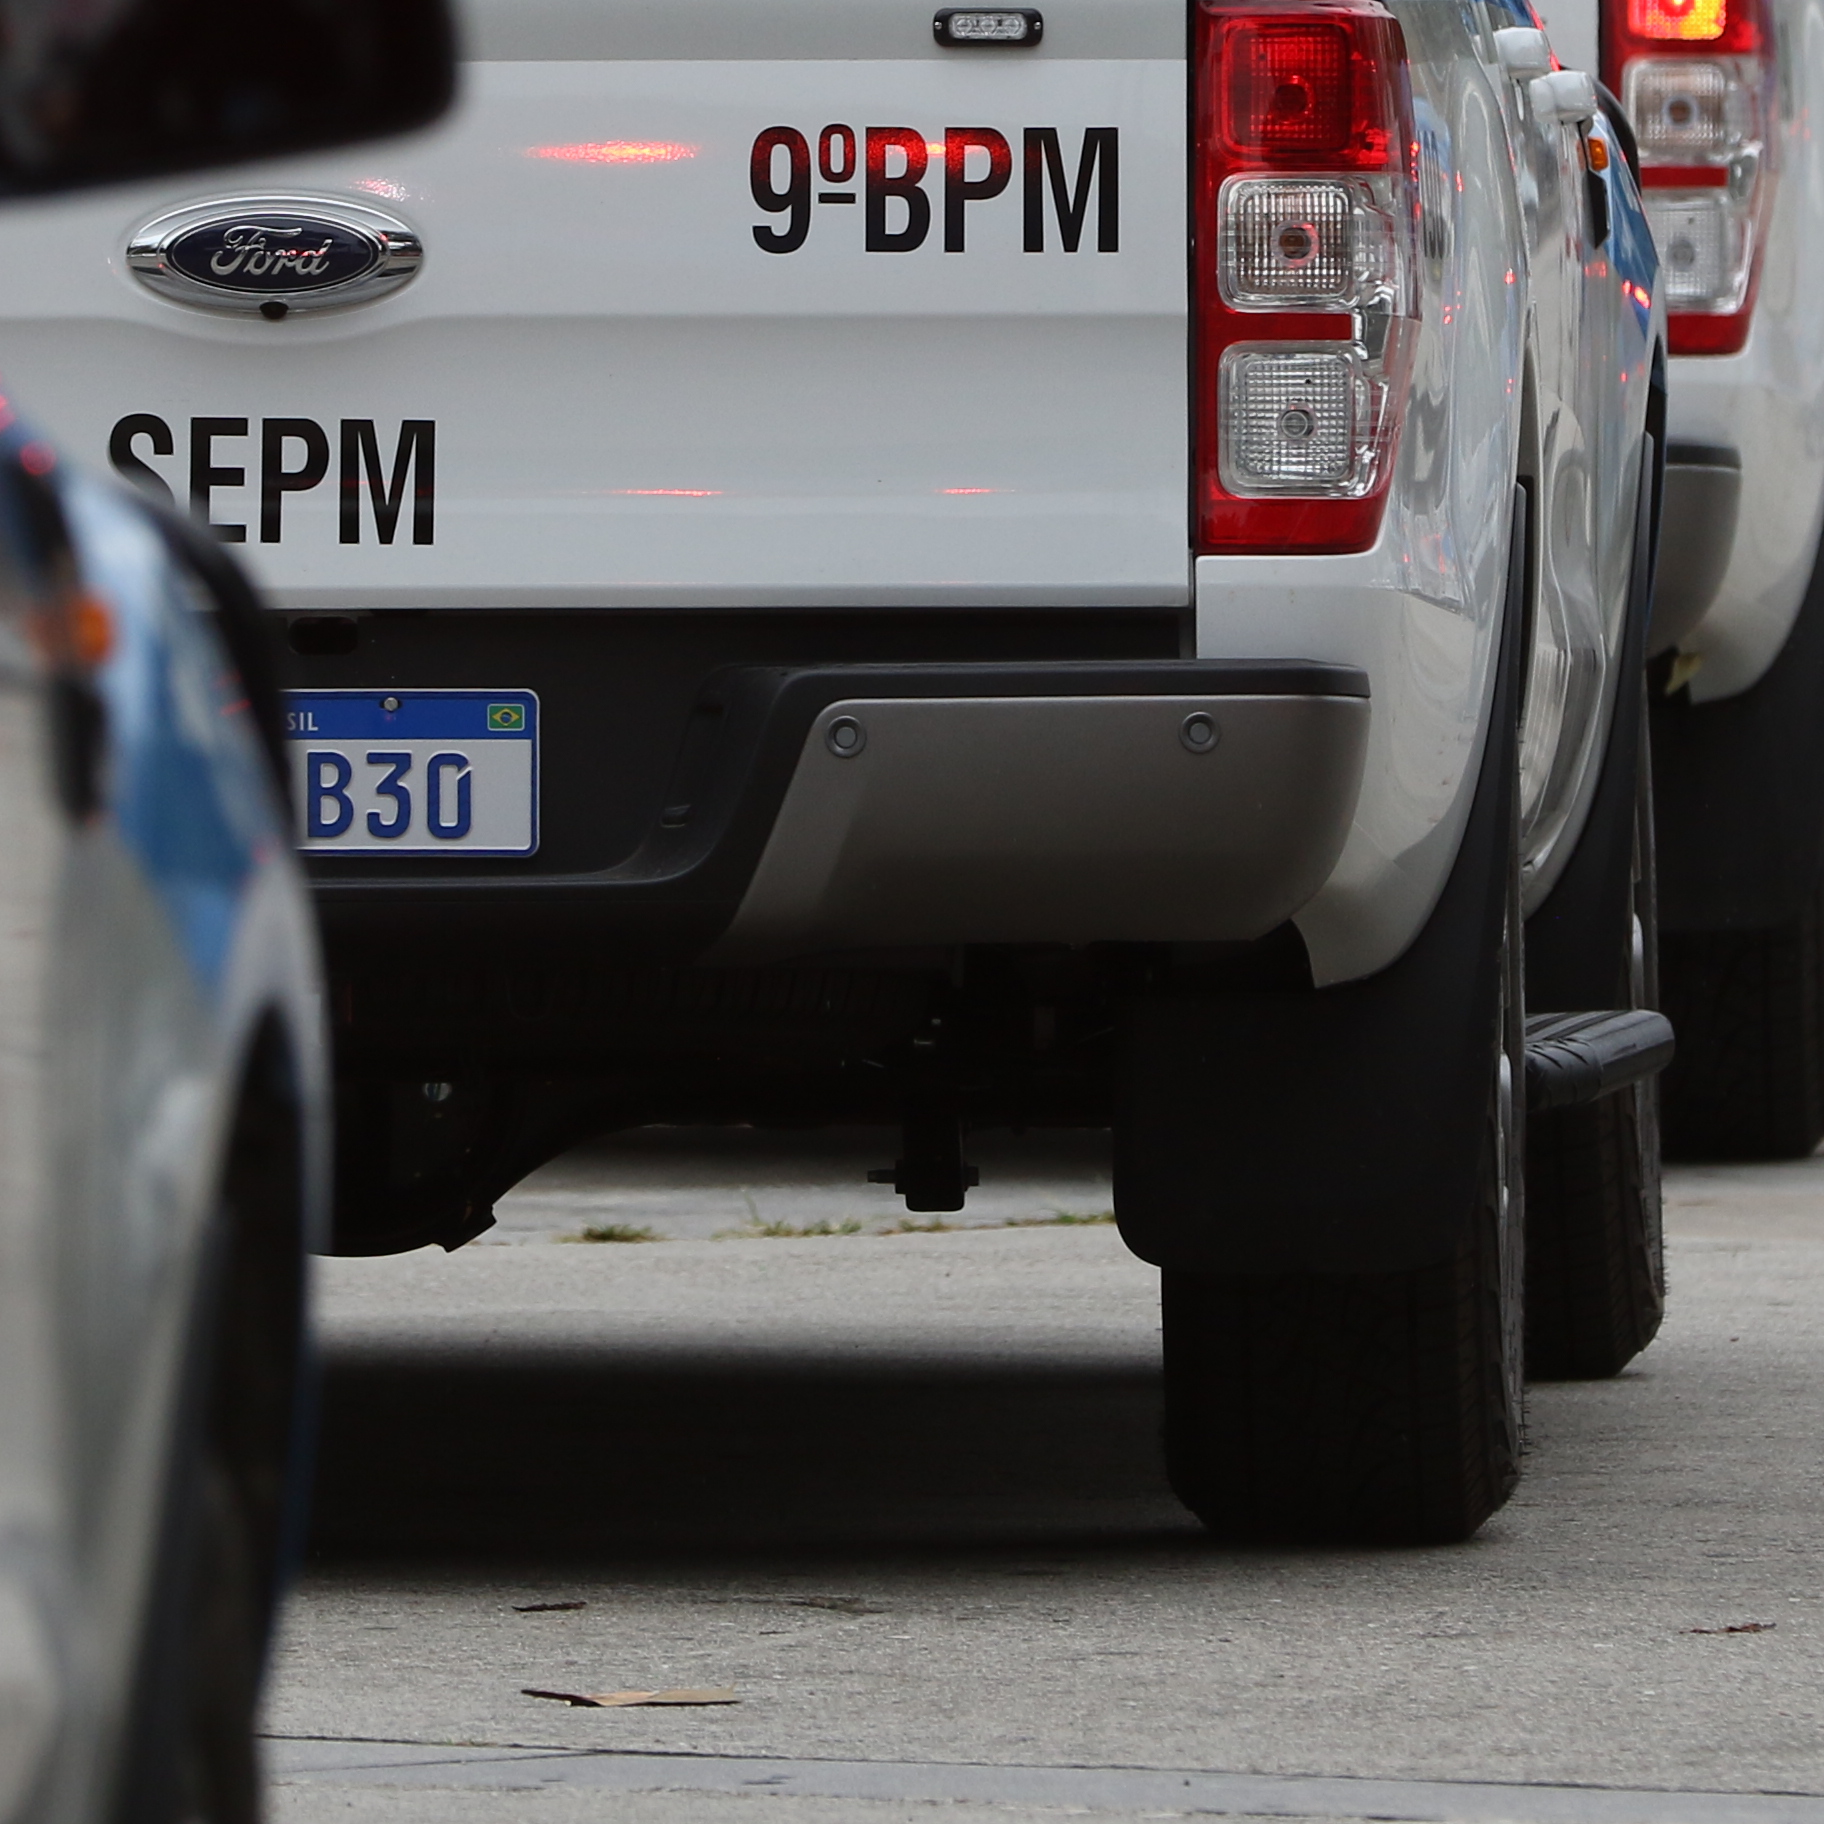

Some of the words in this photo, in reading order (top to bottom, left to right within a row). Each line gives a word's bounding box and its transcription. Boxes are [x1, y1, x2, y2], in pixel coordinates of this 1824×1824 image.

[210, 225, 332, 276] Ford
[749, 123, 1119, 254] 9ºBPM
[107, 413, 436, 546] SEPM
